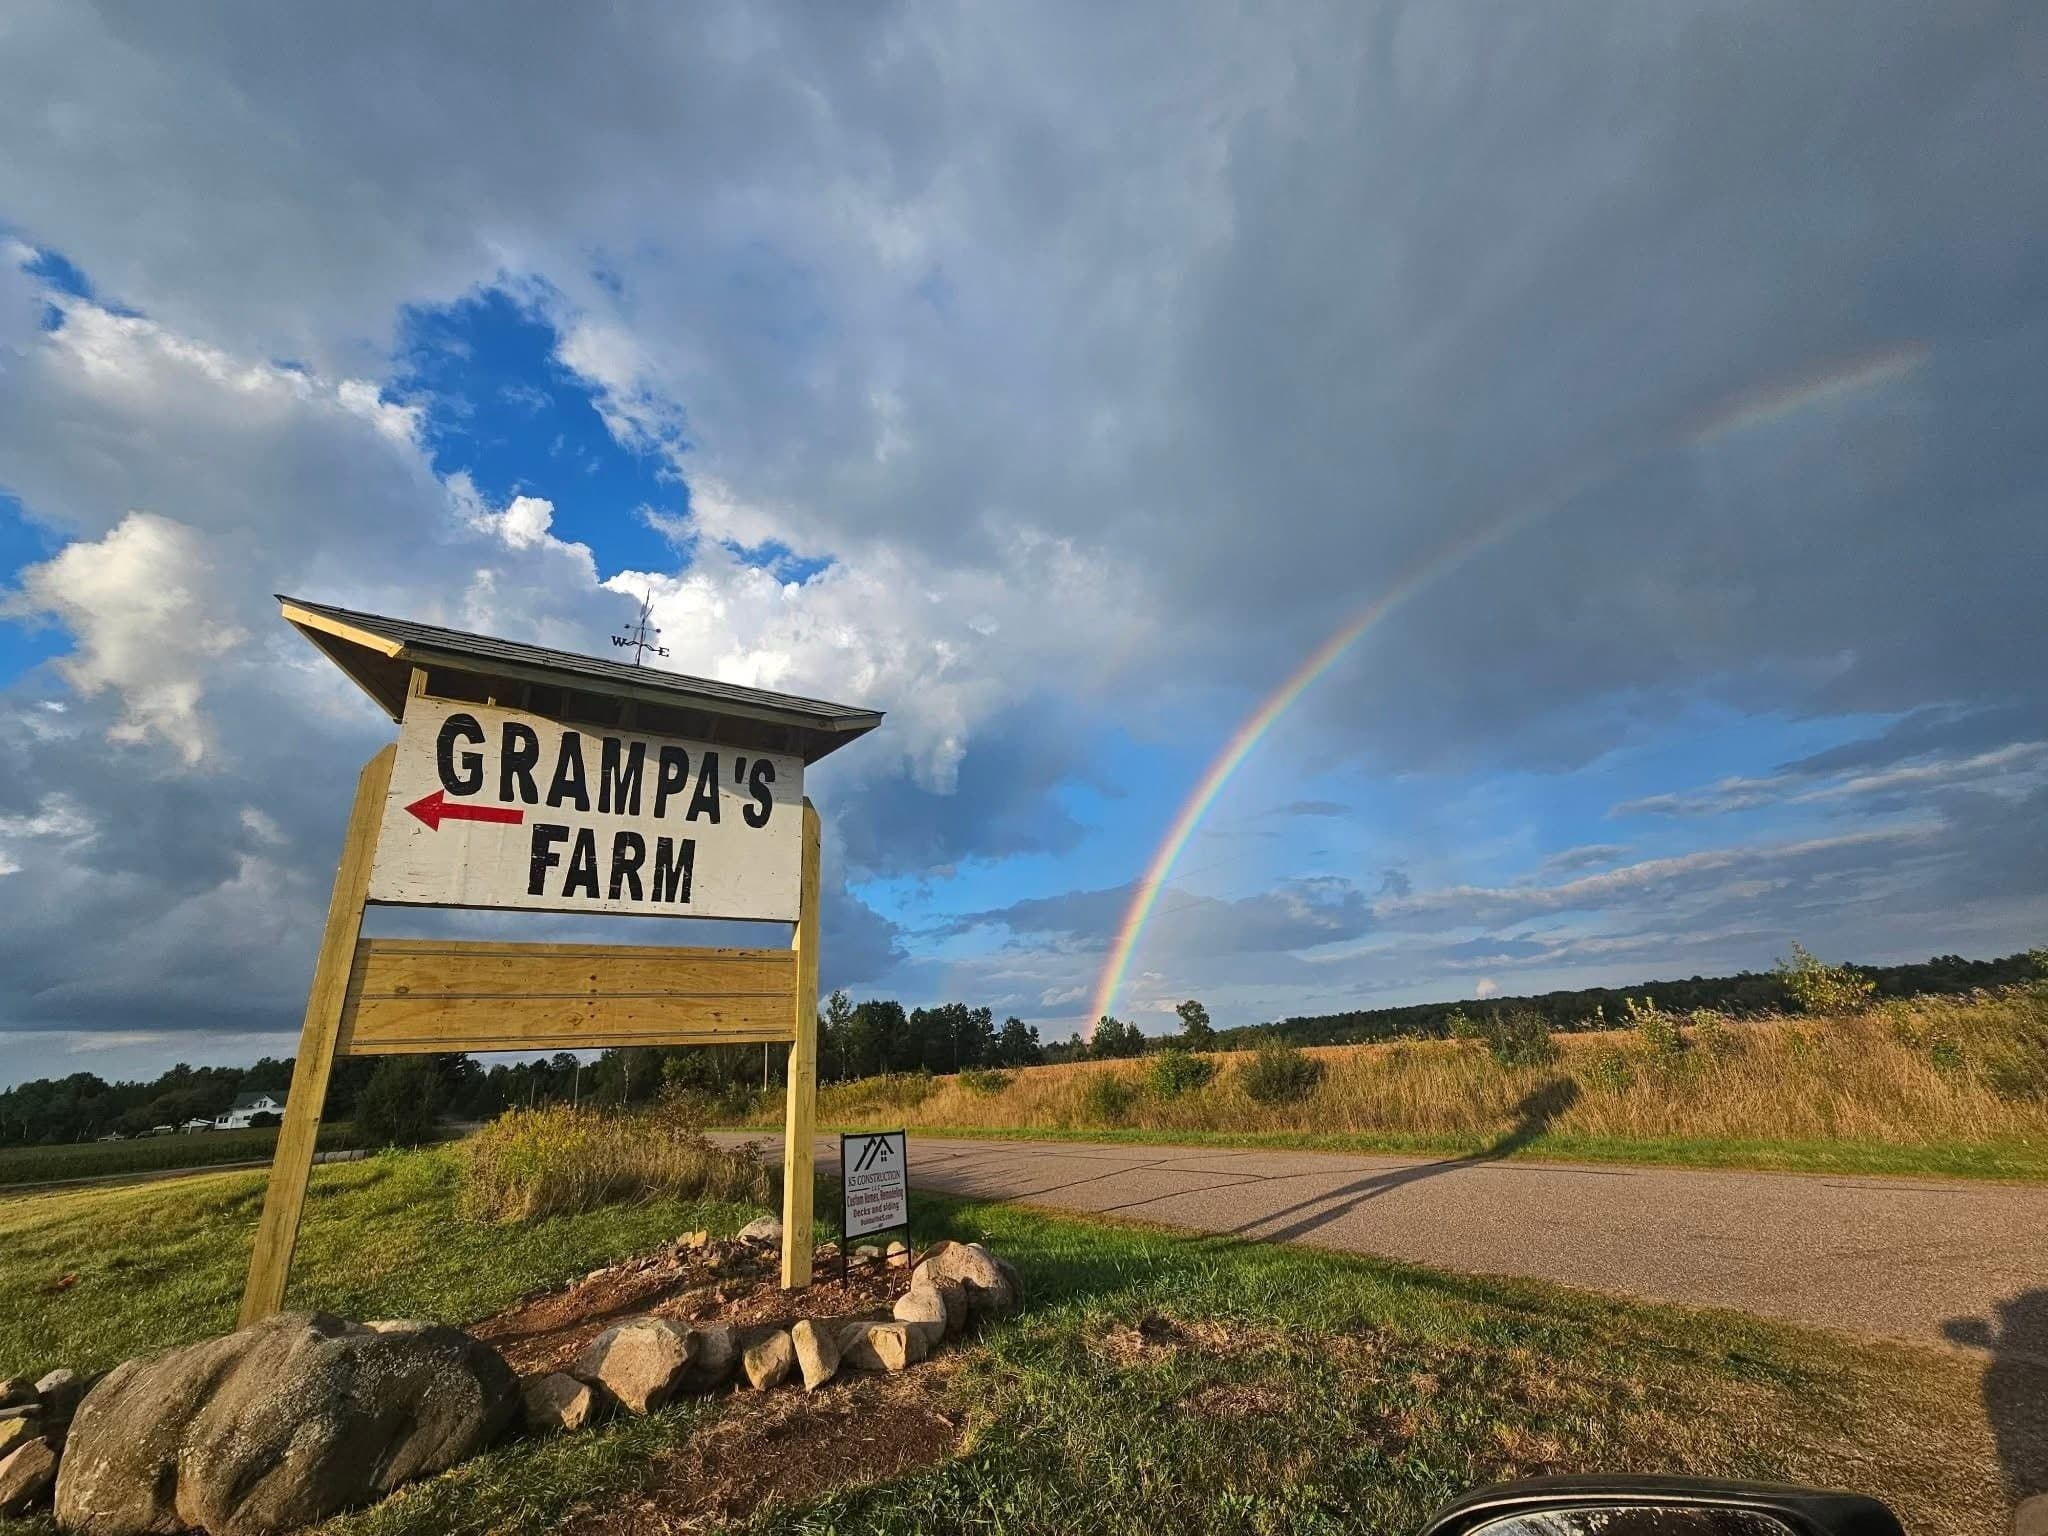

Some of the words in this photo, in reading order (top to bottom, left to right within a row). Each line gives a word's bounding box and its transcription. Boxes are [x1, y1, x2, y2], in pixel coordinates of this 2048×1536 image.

[611, 635, 627, 647] W
[659, 647, 669, 657] E
[436, 713, 776, 828] GRAMPA'S
[527, 823, 696, 904] FARM
[857, 1170, 900, 1185] CONSTRUCTION
[847, 1194, 863, 1207] Custom
[853, 1207, 870, 1217] Decks
[872, 1204, 882, 1213] and
